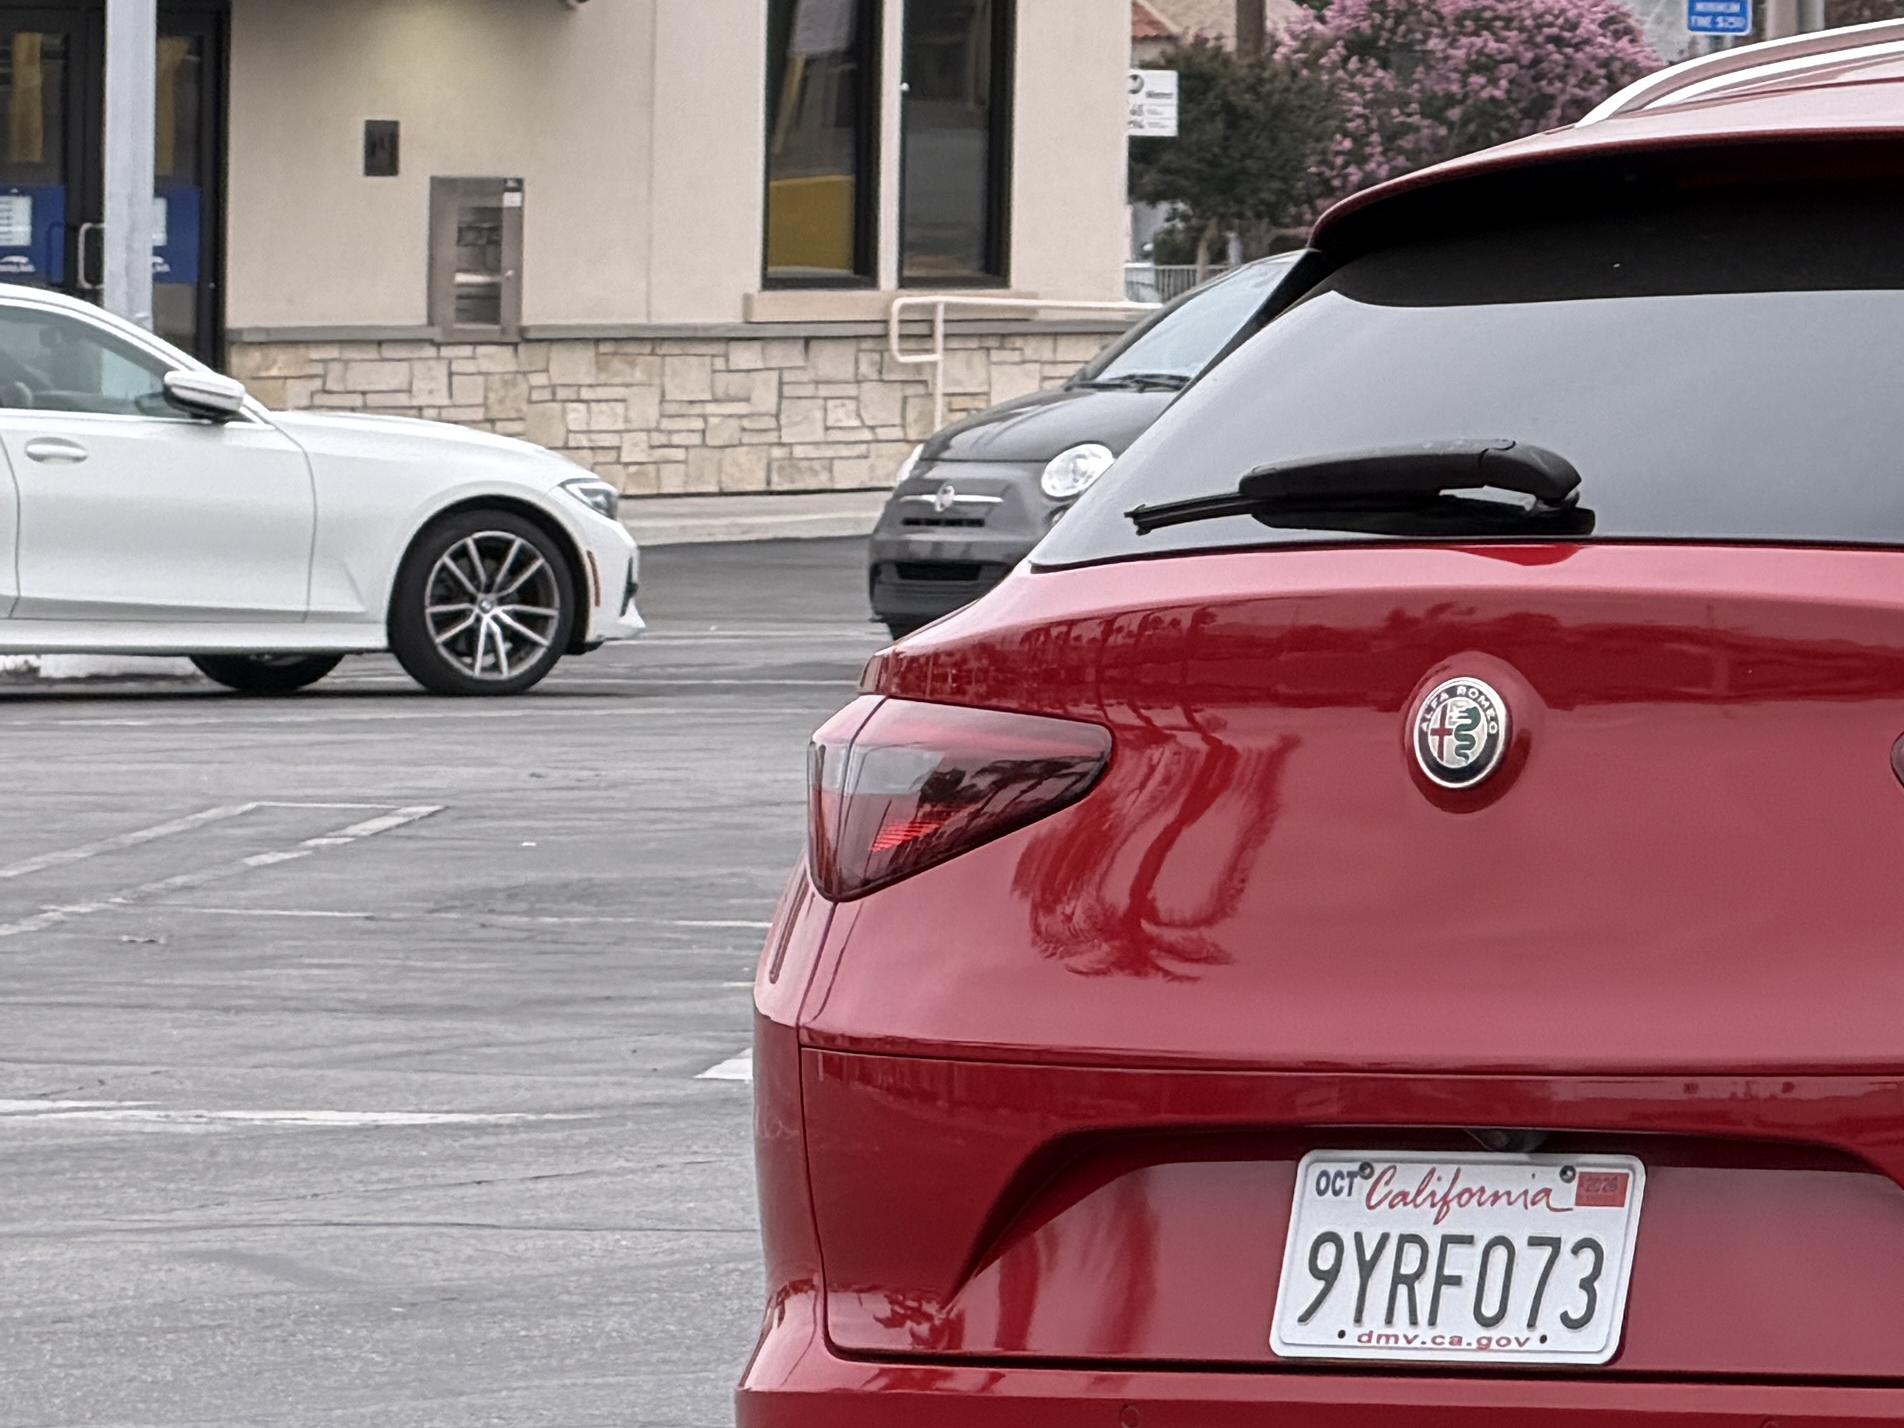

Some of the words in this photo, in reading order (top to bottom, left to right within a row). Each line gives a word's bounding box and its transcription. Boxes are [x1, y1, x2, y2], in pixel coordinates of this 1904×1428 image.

[1420, 691, 1450, 732] ALFA
[1456, 685, 1498, 735] ROMEO
[1315, 1169, 1359, 1198] OCT
[1365, 1164, 1574, 1226] California
[1297, 1230, 1605, 1332] 9YRF073
[1356, 1329, 1532, 1351] dmv.ca.gov
